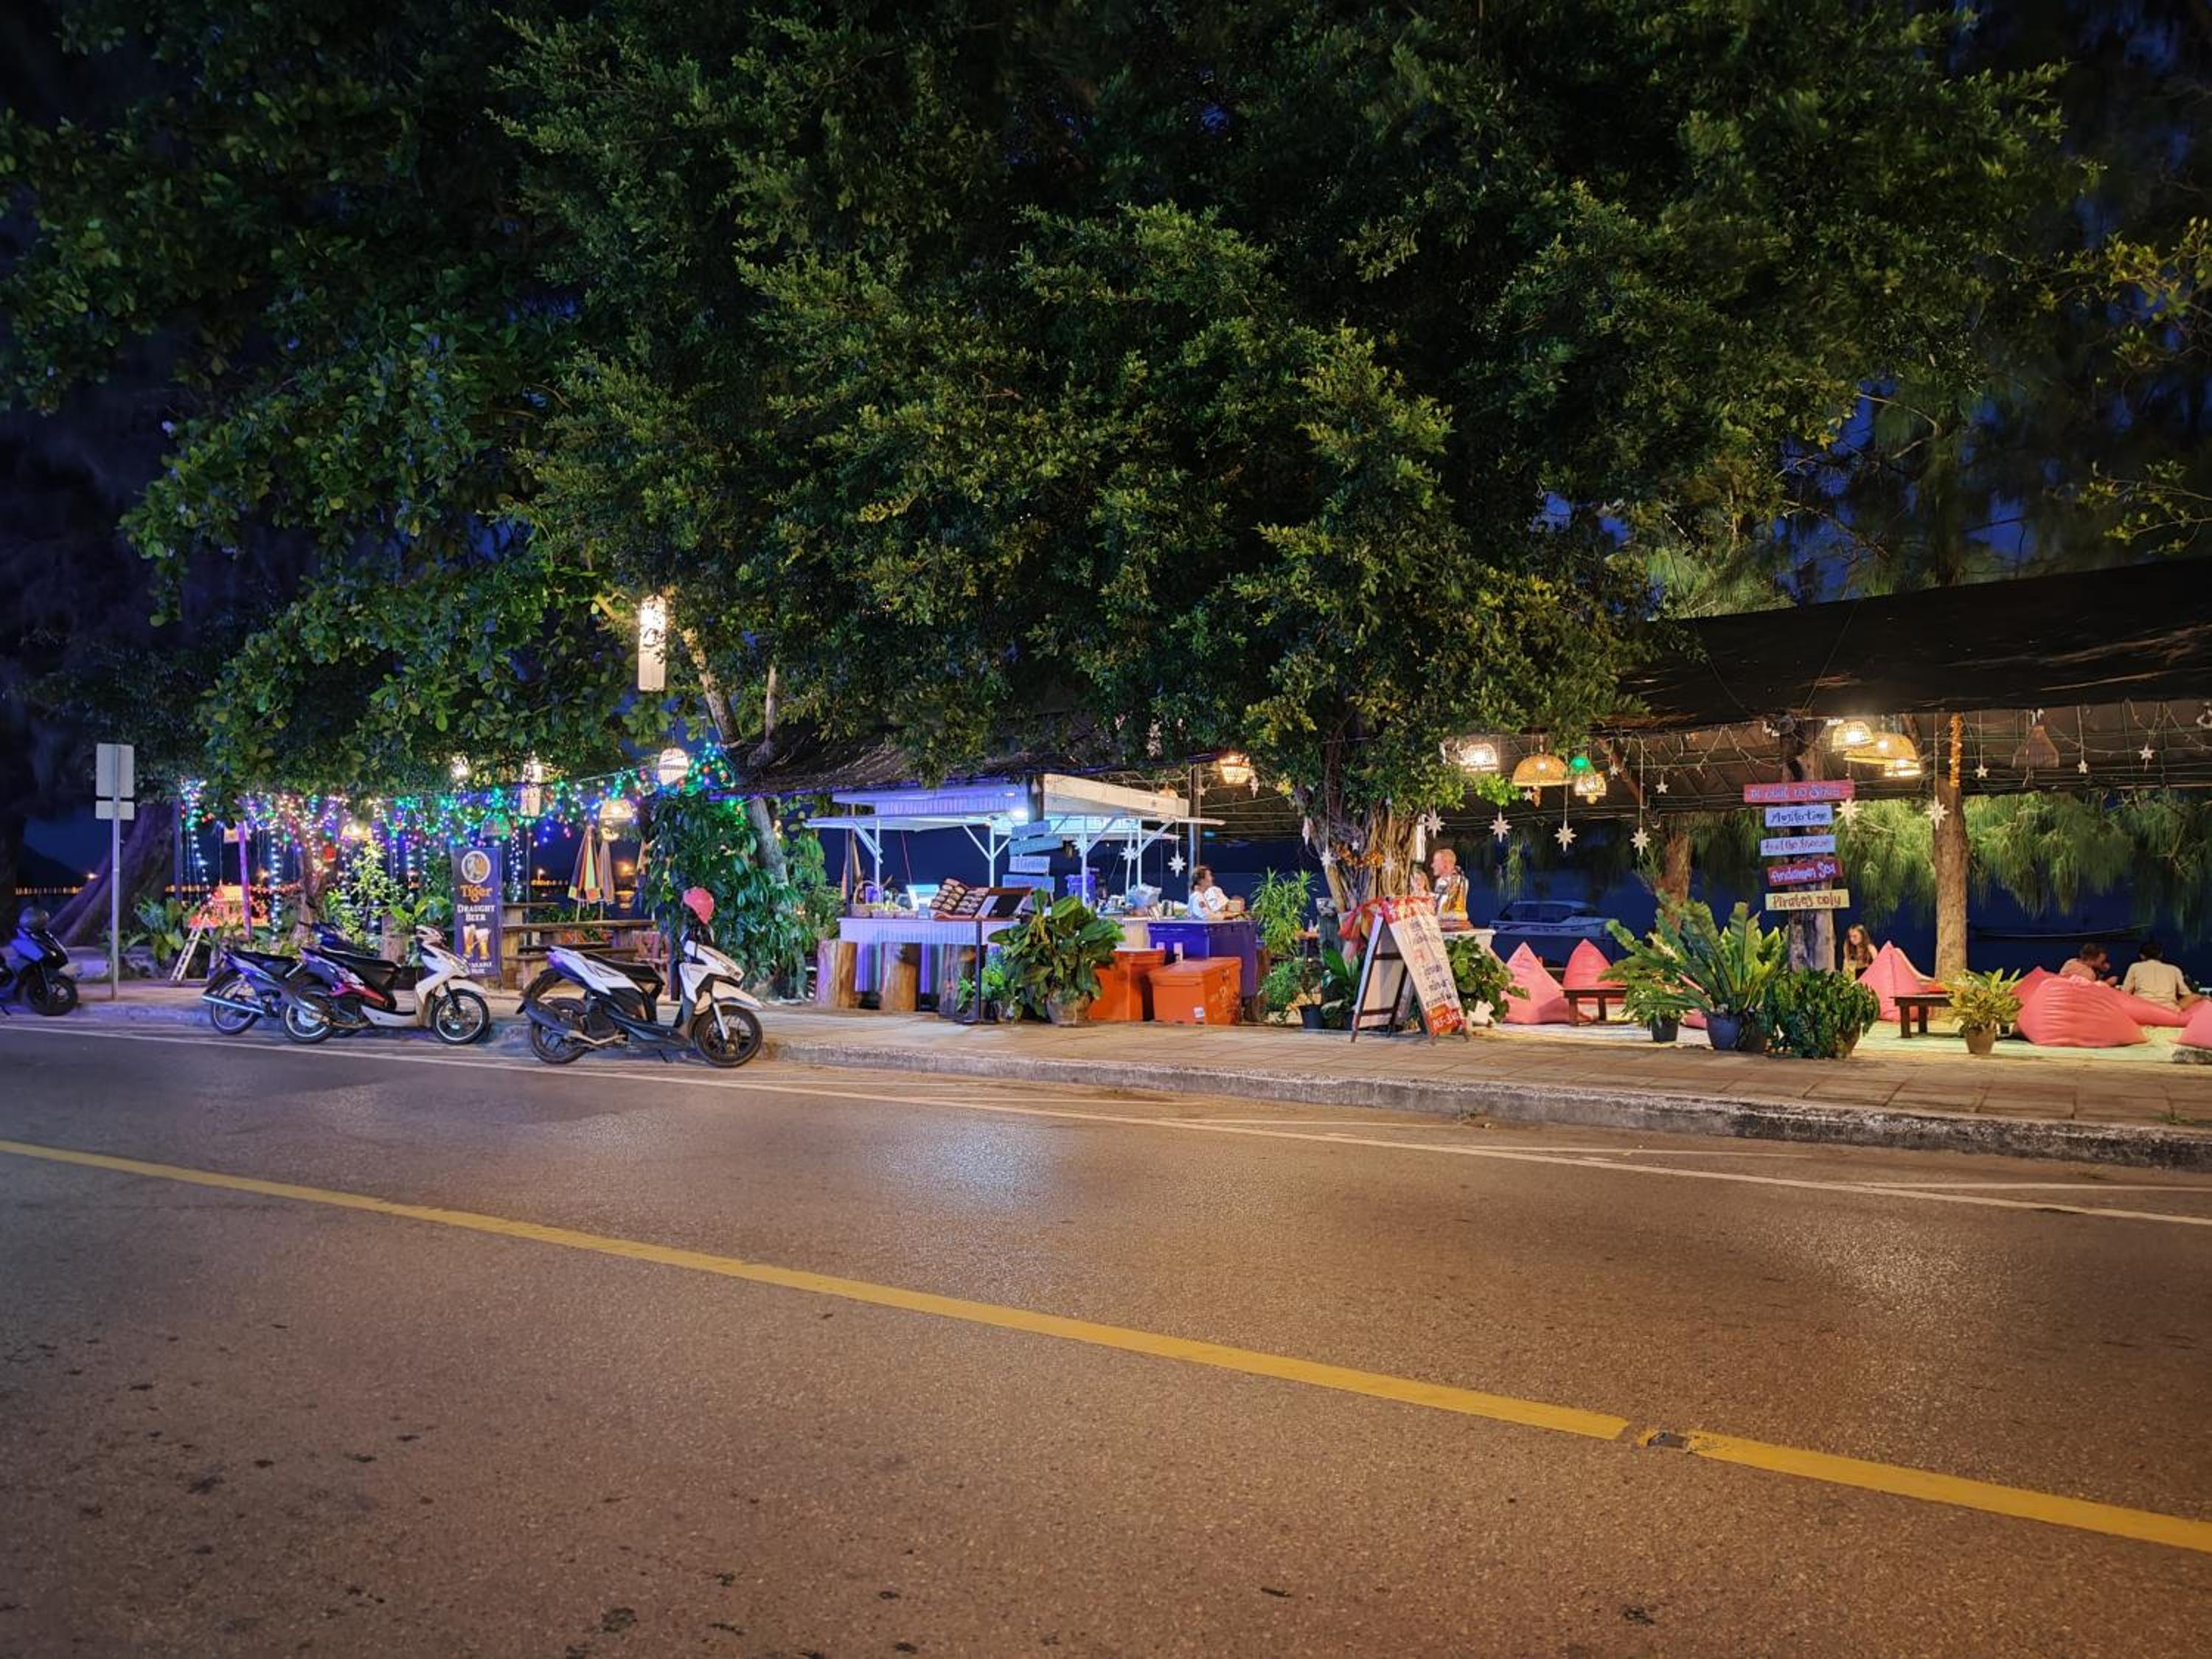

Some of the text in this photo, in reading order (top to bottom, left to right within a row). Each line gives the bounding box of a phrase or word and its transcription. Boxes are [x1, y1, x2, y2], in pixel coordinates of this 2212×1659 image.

[460, 885, 493, 902] Tiger
[456, 905, 495, 914] DRAUGHT
[465, 914, 487, 922] BEER
